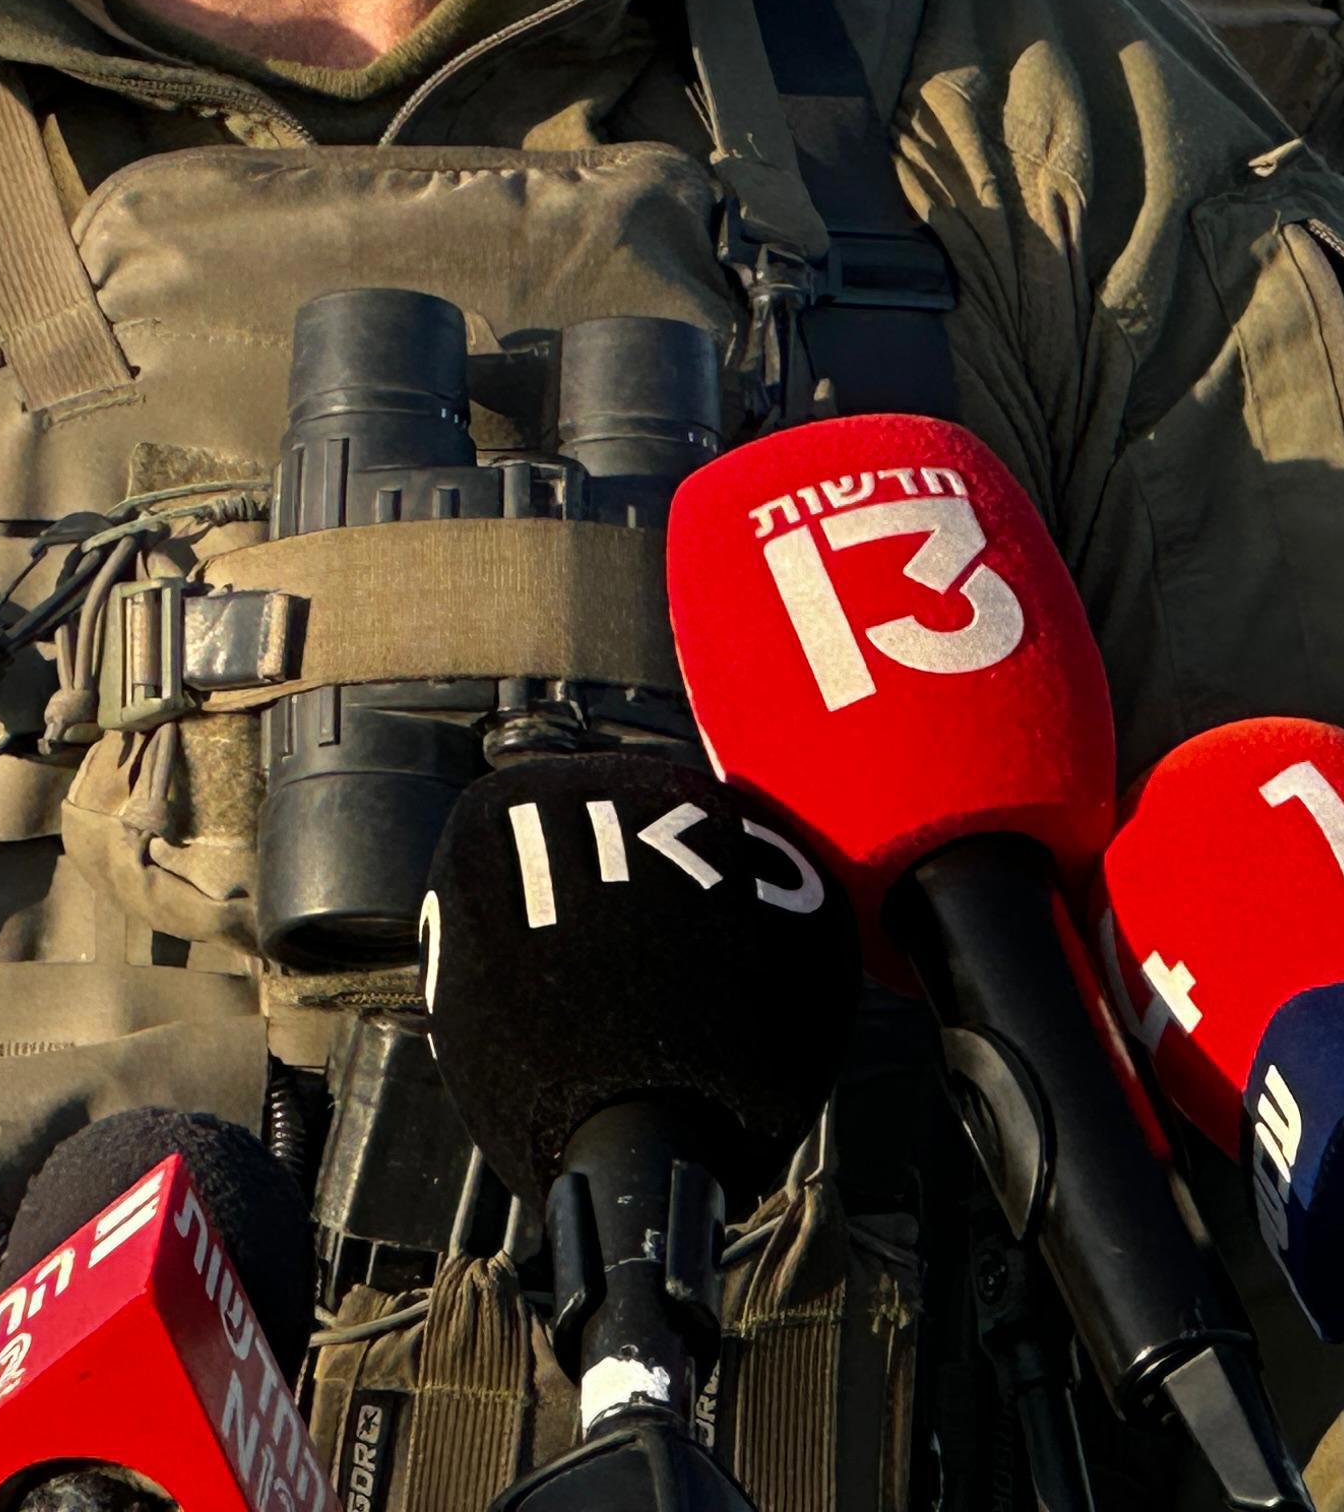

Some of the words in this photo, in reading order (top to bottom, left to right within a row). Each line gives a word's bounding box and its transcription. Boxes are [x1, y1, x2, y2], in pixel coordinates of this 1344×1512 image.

[749, 467, 968, 539] חדשות
[763, 497, 1026, 712] 13
[509, 800, 824, 929] כאן
